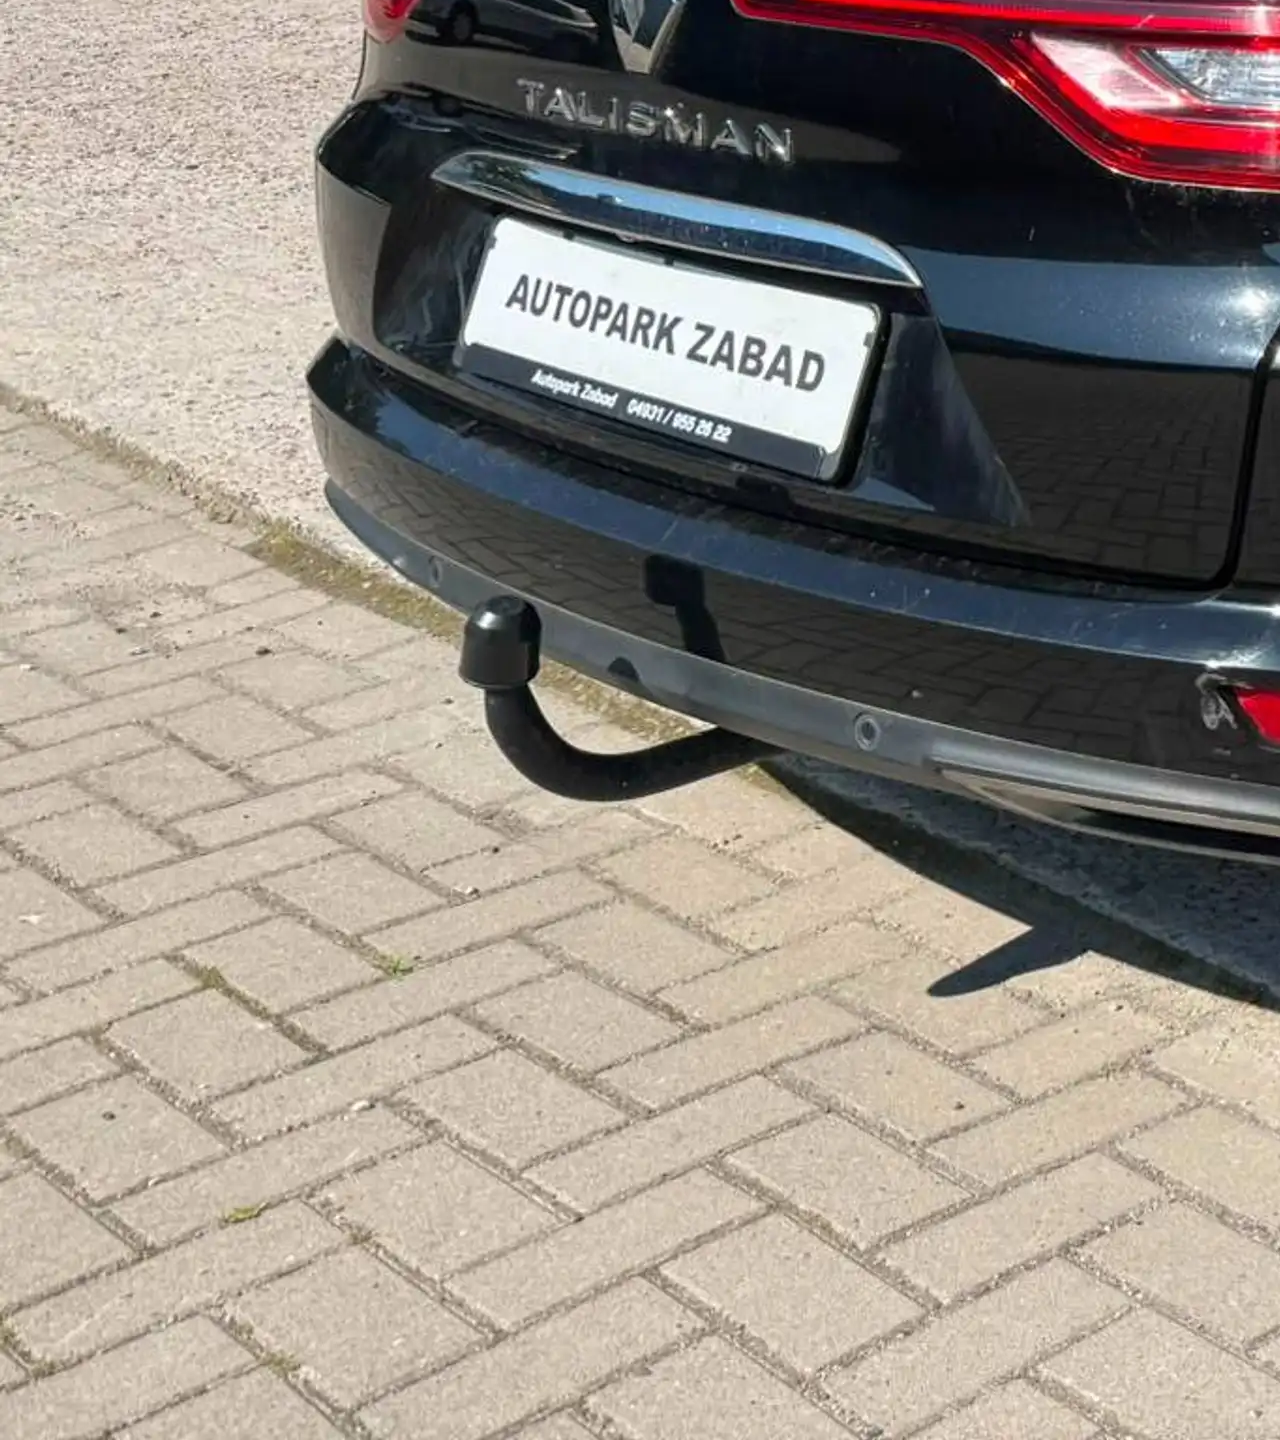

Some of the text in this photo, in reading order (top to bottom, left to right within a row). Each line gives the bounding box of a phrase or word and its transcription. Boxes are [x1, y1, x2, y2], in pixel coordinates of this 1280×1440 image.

[516, 77, 794, 162] TALISMAN
[504, 273, 826, 392] AUTOPARK ZABAD
[530, 368, 582, 398] Autopark
[580, 382, 619, 409] Zabad
